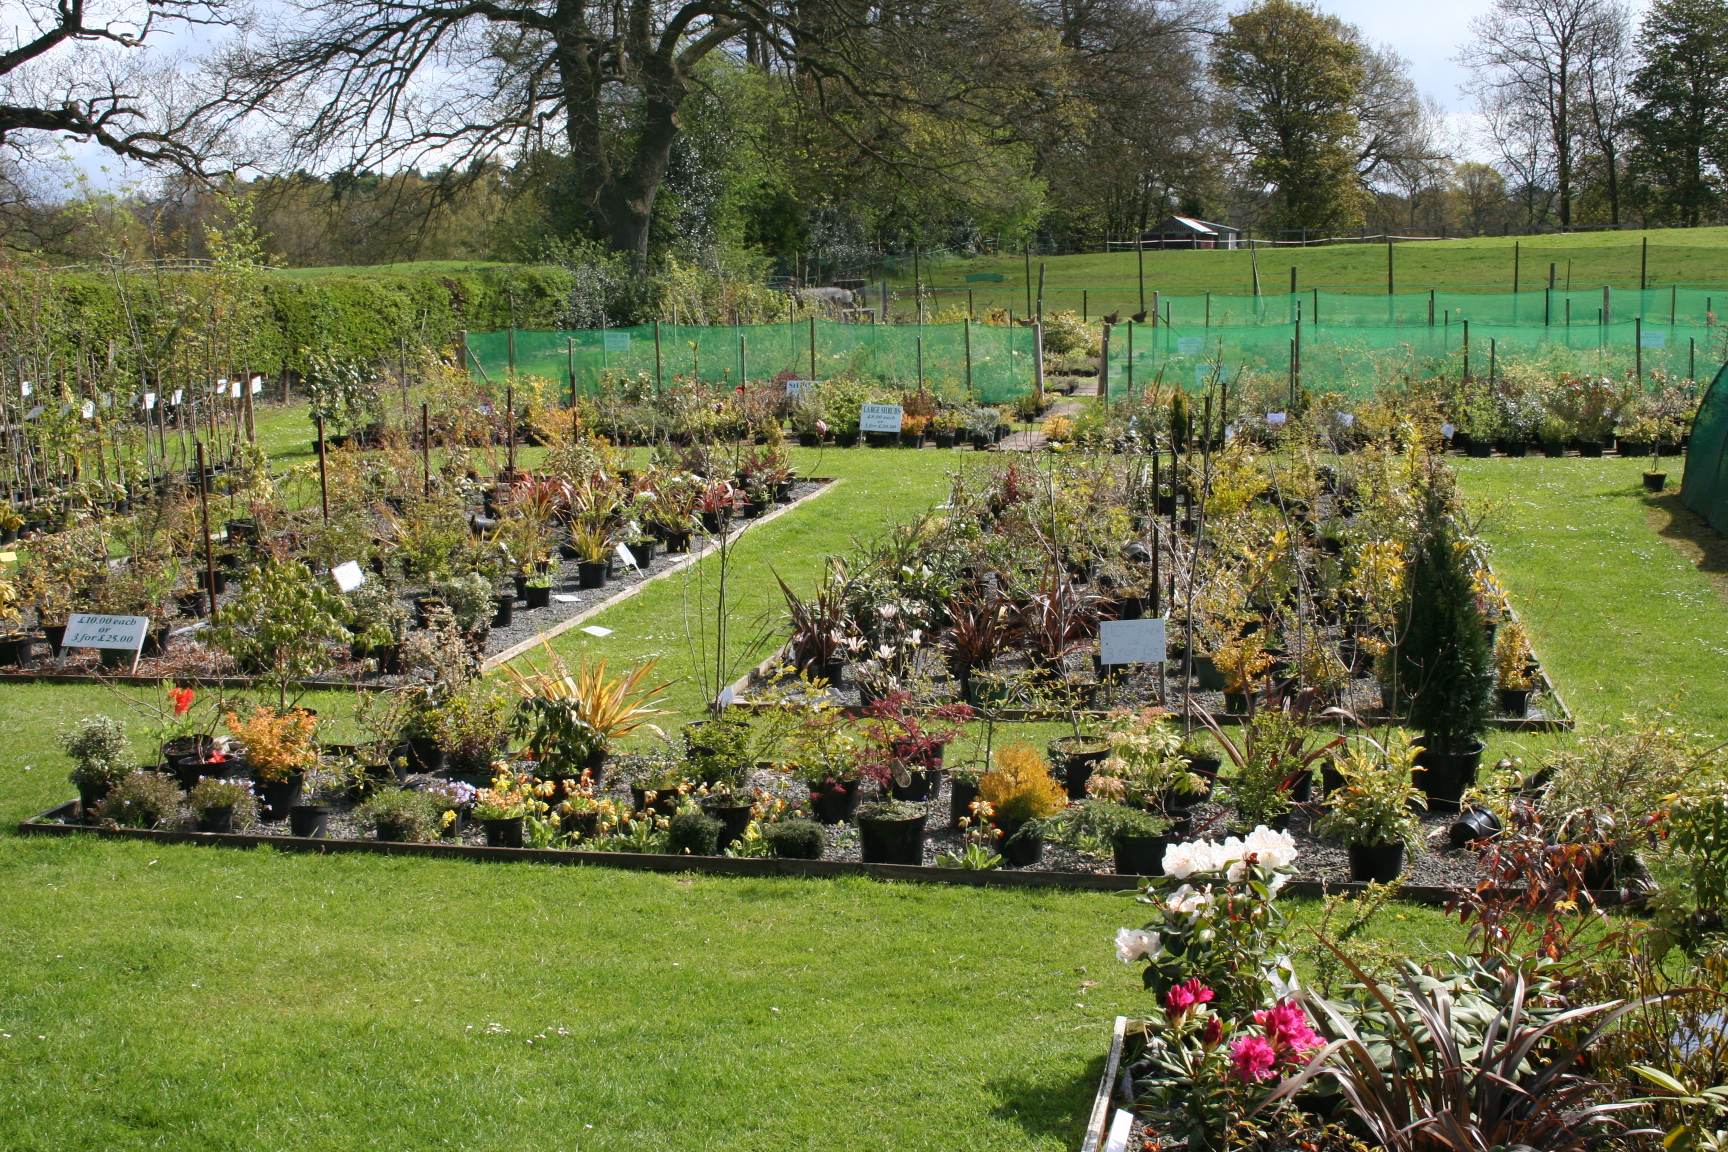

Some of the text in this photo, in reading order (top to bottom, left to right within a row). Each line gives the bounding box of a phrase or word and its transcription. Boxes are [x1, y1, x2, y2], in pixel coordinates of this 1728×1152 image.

[863, 405, 901, 415] LARGE SHRUBS
[77, 616, 137, 626] £10.00 each
[98, 626, 112, 634] or
[77, 633, 98, 643] for
[97, 634, 134, 643] £25.00
[1118, 647, 1137, 656] FOR
